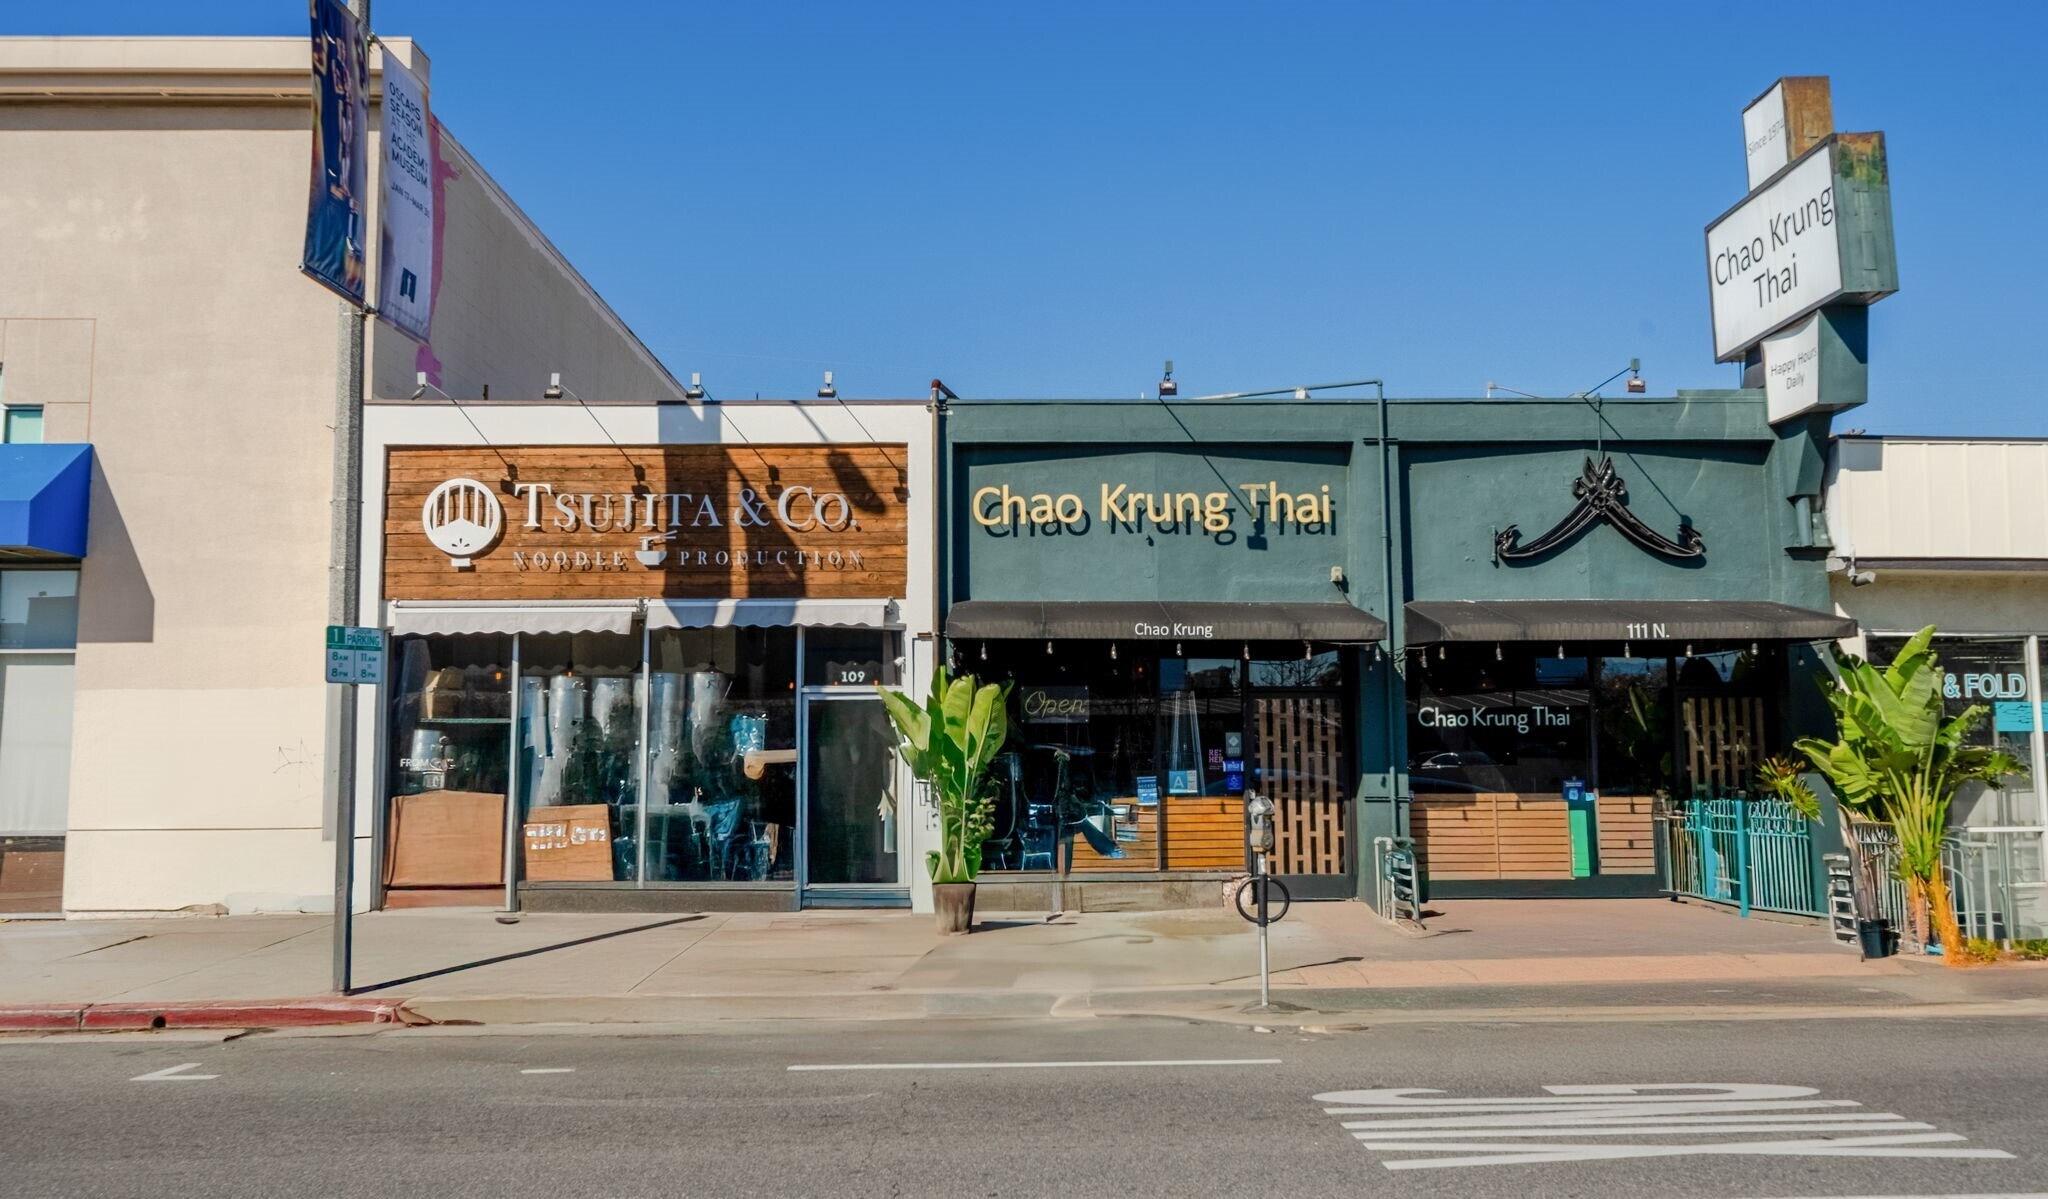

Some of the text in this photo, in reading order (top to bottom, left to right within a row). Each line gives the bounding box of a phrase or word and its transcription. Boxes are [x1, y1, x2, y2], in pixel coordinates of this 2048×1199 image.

[389, 82, 421, 121] OSCARS
[390, 98, 423, 138] SEASON
[391, 116, 400, 132] AT
[391, 132, 428, 174] ACADEMY
[1748, 136, 1767, 157] Since
[391, 148, 428, 188] MUSEUM
[1714, 186, 1834, 286] Chao Krung
[1753, 253, 1799, 308] Thai
[1771, 359, 1796, 377] Happy
[1786, 373, 1805, 390] Daily
[734, 489, 771, 527] &
[973, 481, 1331, 531] Chao Krung Thai
[513, 551, 865, 566] NOODLE PRODUCTION
[334, 628, 339, 642] 1
[347, 635, 380, 645] PARKING
[1134, 623, 1213, 639] Chao Krung
[1627, 623, 1670, 638] 111 N.
[841, 671, 866, 682] 109
[1943, 673, 2027, 699] & FOLD
[1024, 691, 1087, 716] Open
[1418, 705, 1570, 734] Chao Krung Thai
[400, 758, 429, 768] FROM
[1173, 775, 1184, 788] A
[1312, 1082, 2017, 1170] XING
